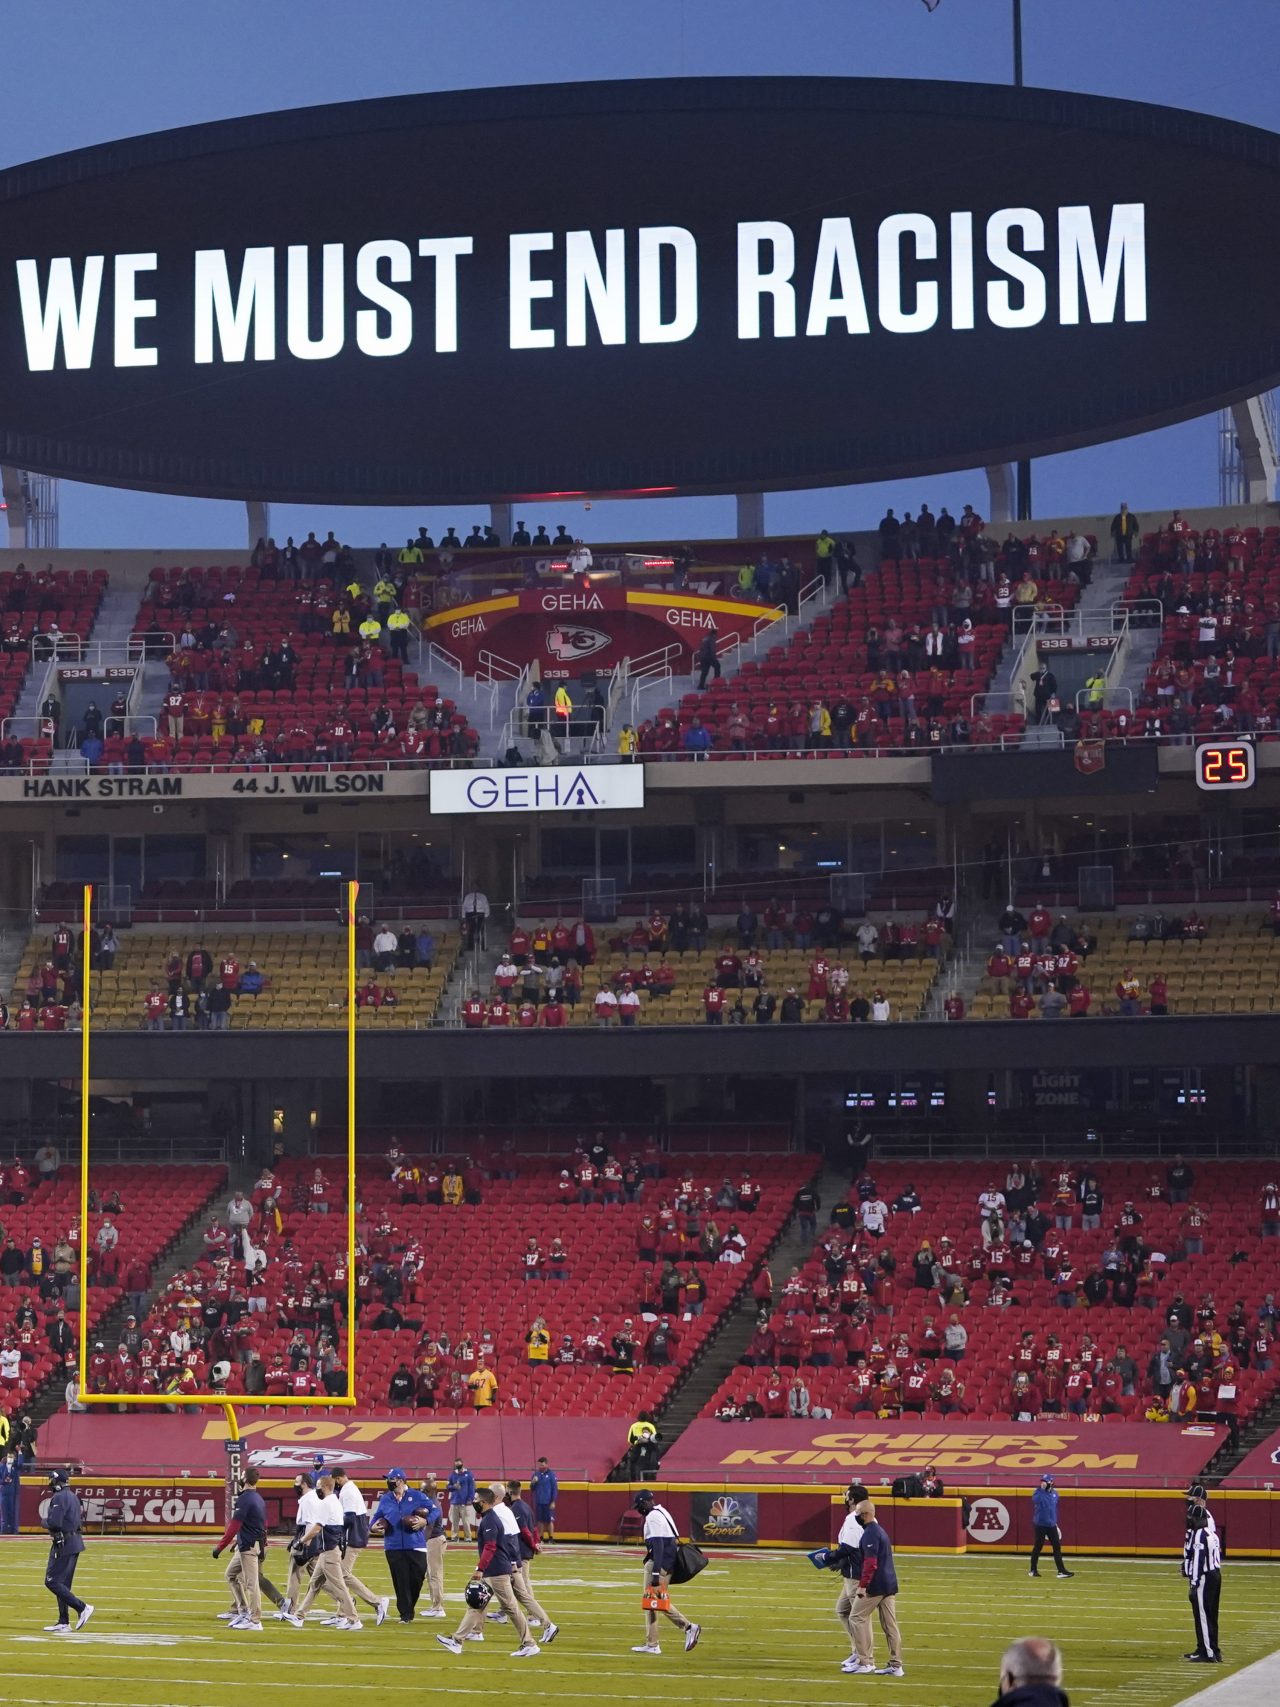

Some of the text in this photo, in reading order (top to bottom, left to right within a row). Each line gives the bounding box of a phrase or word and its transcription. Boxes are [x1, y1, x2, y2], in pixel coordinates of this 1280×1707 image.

[16, 203, 1147, 371] WE MUST END RACISM
[542, 593, 603, 611] GEHA
[666, 609, 715, 629] GEHA
[452, 616, 485, 638] GEHA
[1041, 637, 1117, 648] 336 337
[62, 668, 134, 678] 334 335
[544, 670, 569, 678] 335
[169, 696, 181, 706] 87
[335, 727, 344, 735] 10
[1204, 751, 1246, 782] 25
[24, 777, 182, 798] HANK STRAM
[233, 775, 384, 794] 44 J. WILSON
[466, 772, 600, 808] GEHA
[1018, 958, 1031, 967] 22
[224, 965, 234, 974] 15
[150, 997, 160, 1006] 15
[709, 992, 718, 1002] 15
[471, 1004, 480, 1013] 10
[493, 1007, 503, 1016] 10
[1032, 1075, 1081, 1088] LIGHT
[1035, 1092, 1079, 1105] ZONE
[582, 1170, 592, 1180] 15
[991, 1252, 1003, 1263] 15
[335, 1270, 345, 1280] 15
[842, 1281, 857, 1292] 58
[187, 1355, 198, 1364] 10
[462, 1350, 474, 1360] 15
[1020, 1350, 1031, 1360] 15
[1047, 1350, 1060, 1360] 58
[1082, 1352, 1092, 1361] 15
[142, 1357, 152, 1366] 15
[296, 1377, 307, 1387] 15
[858, 1375, 869, 1385] 15
[909, 1377, 923, 1388] 87
[201, 1421, 471, 1442] VOTE
[811, 1433, 1079, 1450] CHIEFS
[719, 1449, 1139, 1468] KINGDOM
[115, 1489, 184, 1497] TICKETS
[709, 1515, 742, 1528] NBC
[971, 1507, 1004, 1530] A
[702, 1523, 746, 1536] Sports
